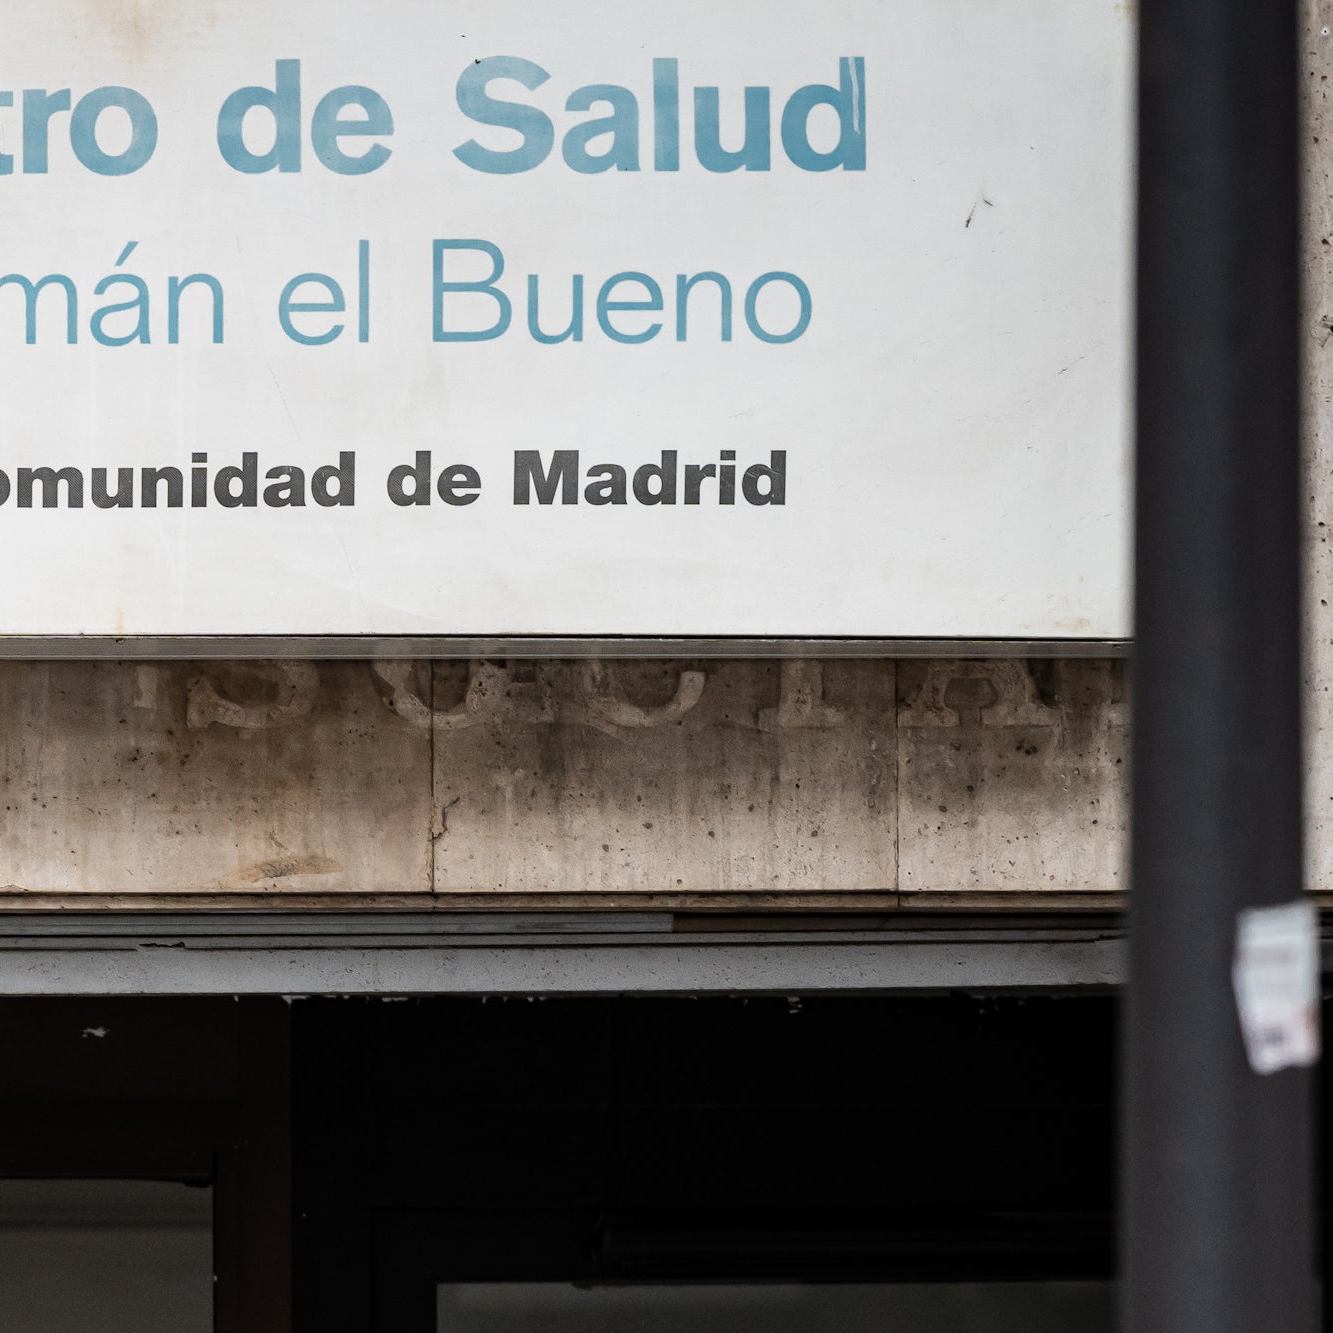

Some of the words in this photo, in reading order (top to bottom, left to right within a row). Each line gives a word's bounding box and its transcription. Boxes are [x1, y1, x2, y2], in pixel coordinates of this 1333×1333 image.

[217, 57, 394, 176] de
[452, 55, 870, 175] Salud
[279, 240, 370, 347] el
[431, 239, 813, 345] Bueno
[386, 451, 482, 507] de
[512, 449, 788, 507] Madrid
